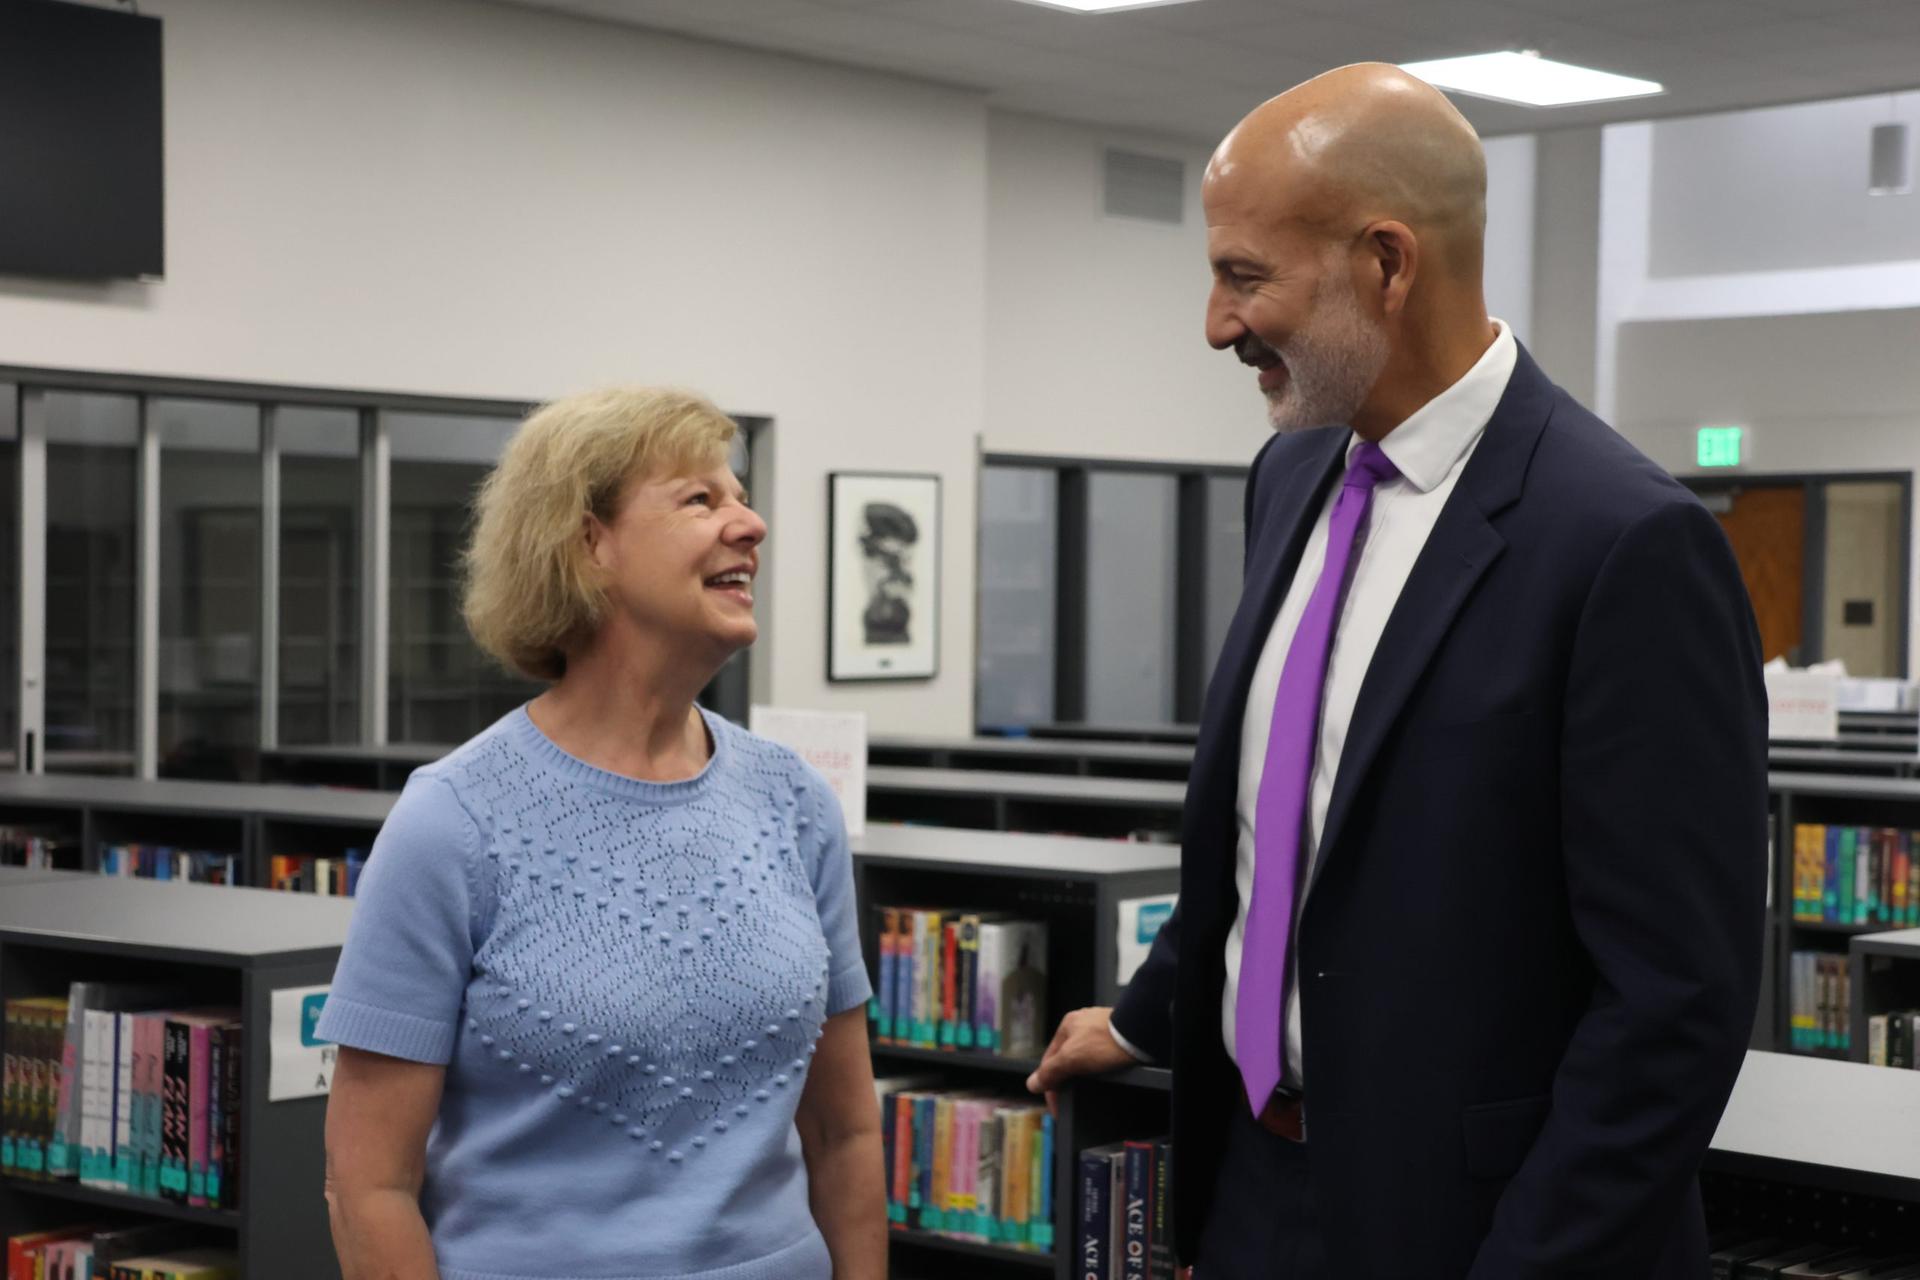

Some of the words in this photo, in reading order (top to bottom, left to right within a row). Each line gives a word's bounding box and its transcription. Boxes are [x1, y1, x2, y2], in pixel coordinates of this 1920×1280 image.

[1127, 1193, 1143, 1235] ACE
[1084, 1234, 1099, 1268] ACE
[1127, 1241, 1143, 1269] OF
